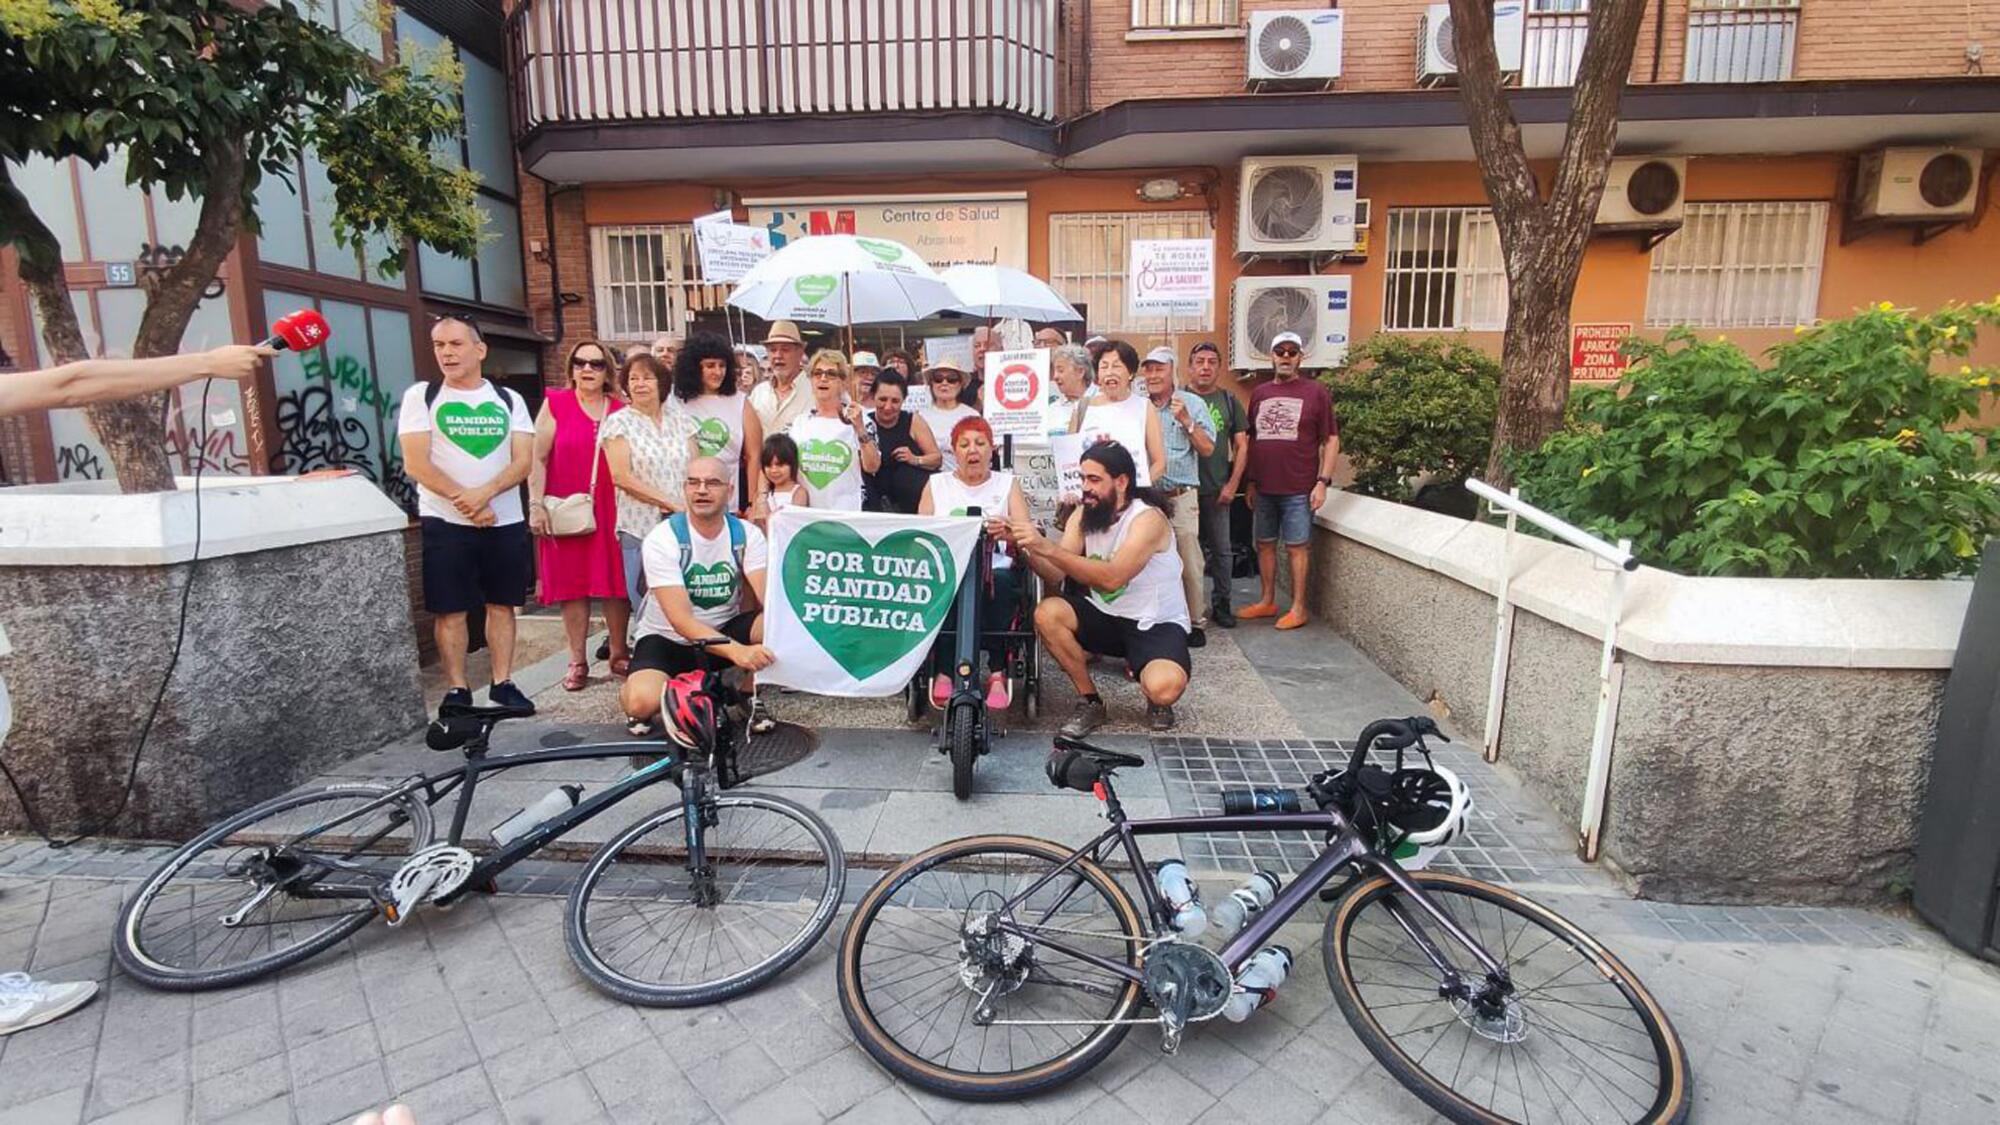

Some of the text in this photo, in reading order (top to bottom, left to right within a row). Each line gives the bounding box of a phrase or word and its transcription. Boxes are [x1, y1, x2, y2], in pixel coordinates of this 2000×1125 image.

[882, 205, 1000, 223] Centro de Salud
[111, 265, 129, 281] 55
[1576, 326, 1629, 338] PROHIBIDO
[1583, 353, 1615, 366] ZONA
[445, 415, 504, 425] SANIDAD
[448, 425, 504, 436] PÚBLICA
[806, 549, 933, 580] POR UNA
[804, 574, 932, 605] SANIDAD
[802, 598, 927, 633] PÚBLICA
